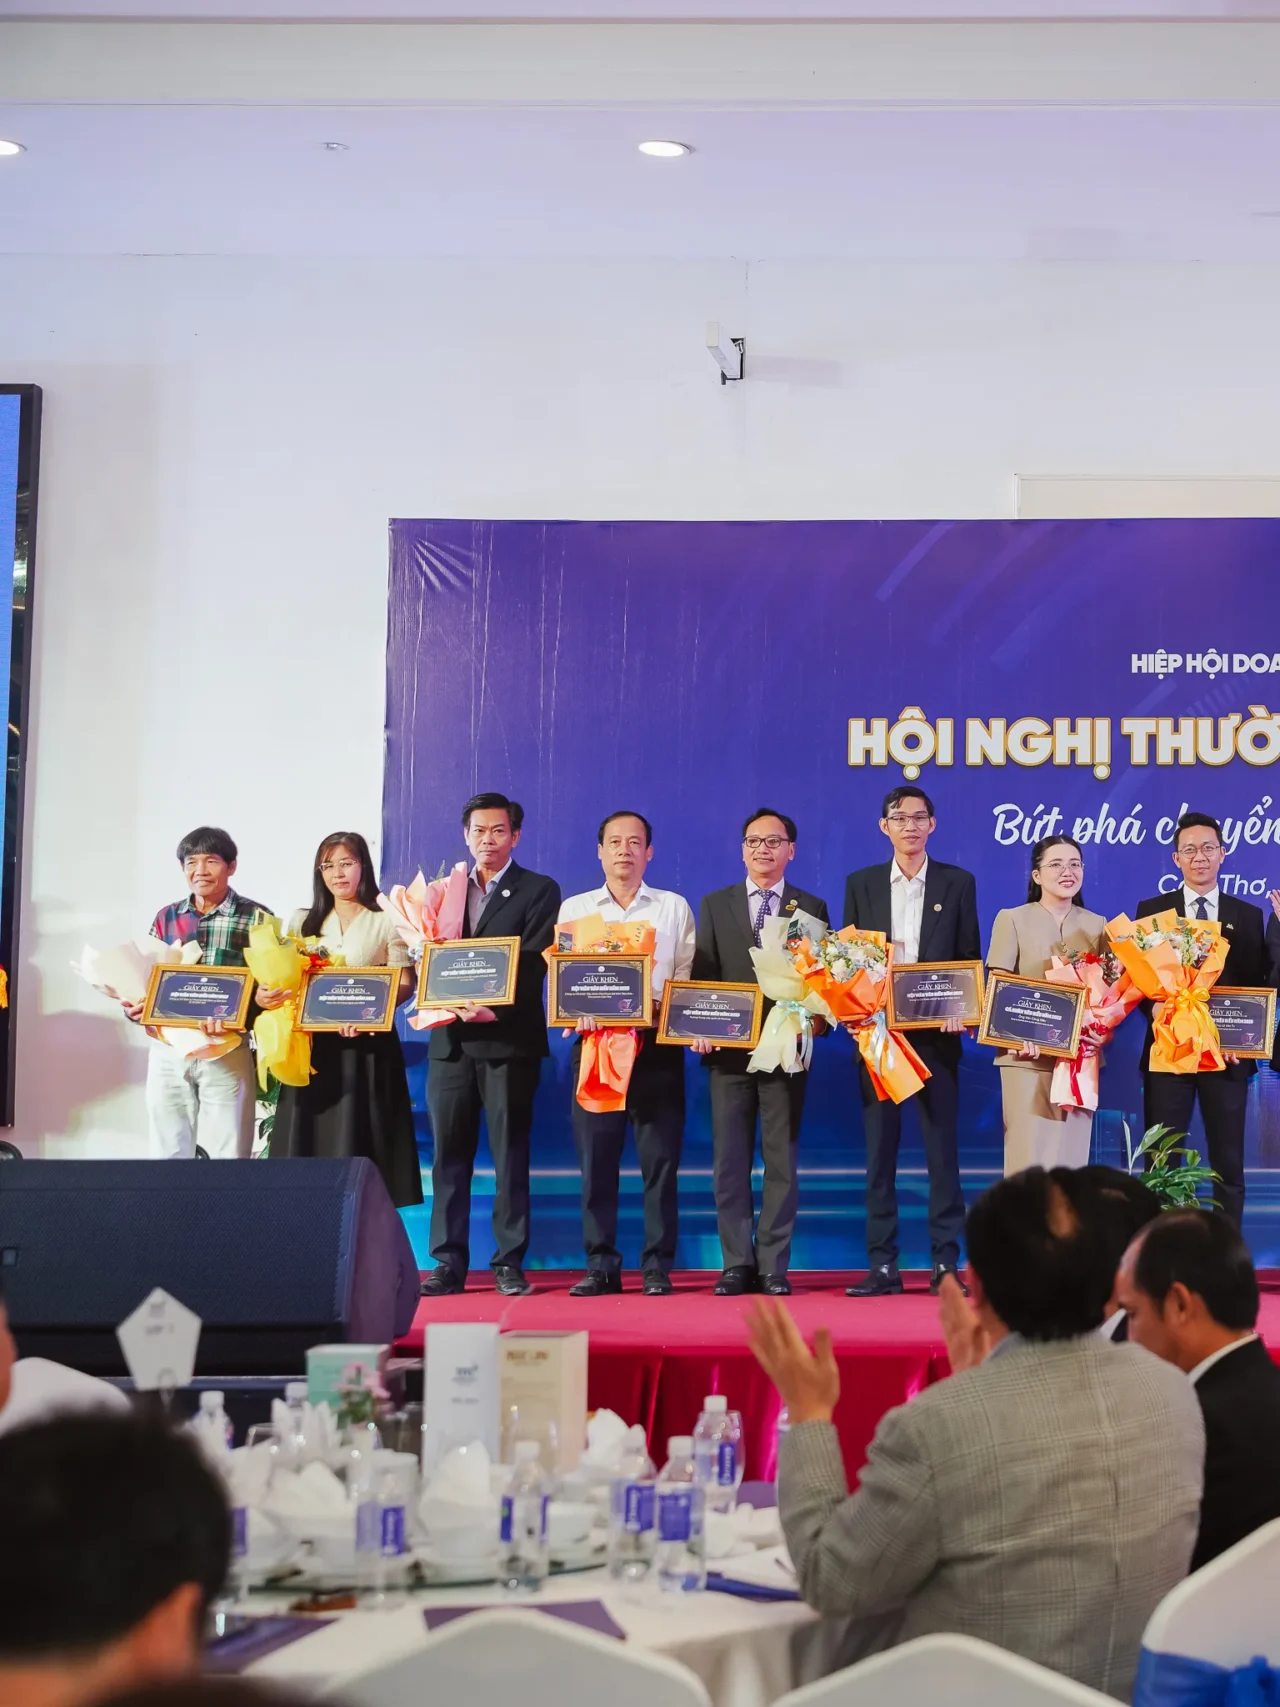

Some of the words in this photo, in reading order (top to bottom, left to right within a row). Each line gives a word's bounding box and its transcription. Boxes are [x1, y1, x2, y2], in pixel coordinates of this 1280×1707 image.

[1131, 648, 1184, 680] HIỆP
[1186, 648, 1229, 680] HỘI
[848, 706, 954, 781] HỘI
[965, 716, 1112, 780] NGHỊ
[992, 803, 1064, 845] Bứt
[1072, 802, 1147, 845] phá
